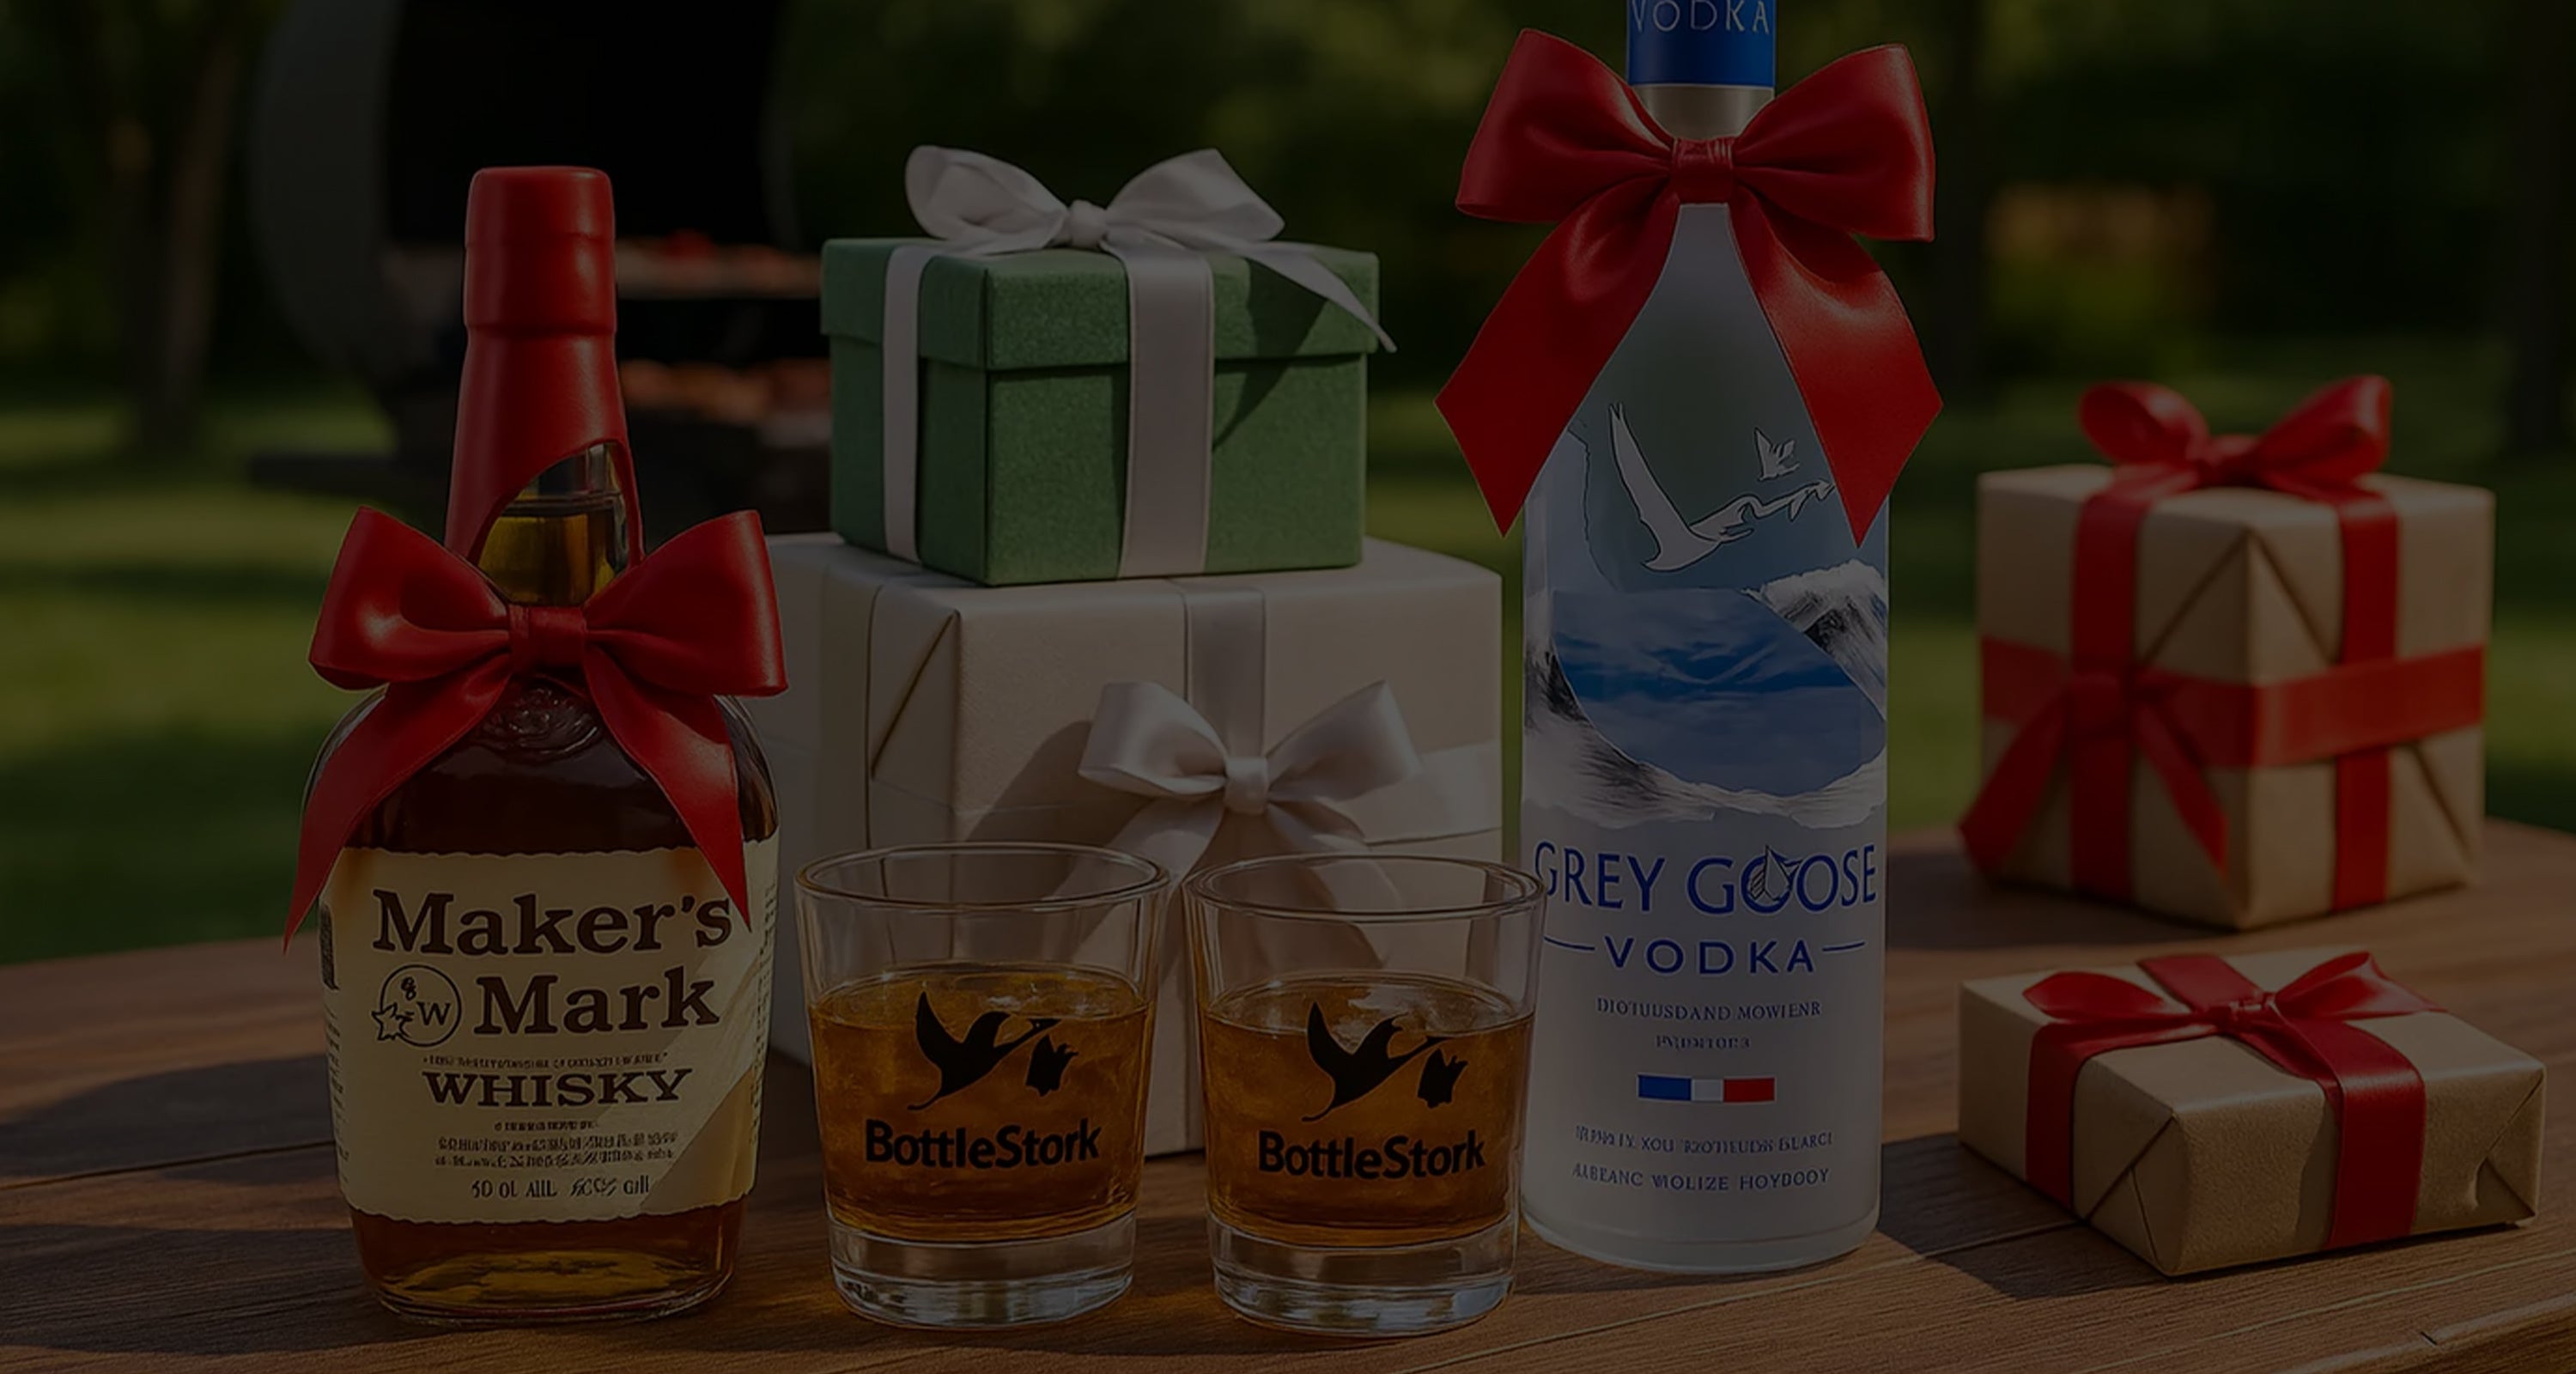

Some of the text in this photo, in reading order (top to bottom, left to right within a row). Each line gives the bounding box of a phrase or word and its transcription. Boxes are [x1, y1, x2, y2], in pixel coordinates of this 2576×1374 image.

[1631, 0, 1778, 34] VODKA
[1534, 840, 1877, 913] GREY GOOSE
[373, 890, 732, 954] Maker's
[1604, 935, 1815, 975] VODKA
[474, 965, 719, 1035] Mark
[422, 1068, 692, 1108] WHISKY
[866, 1118, 1101, 1168] BottleStork
[1259, 1129, 1485, 1179] BottleStork
